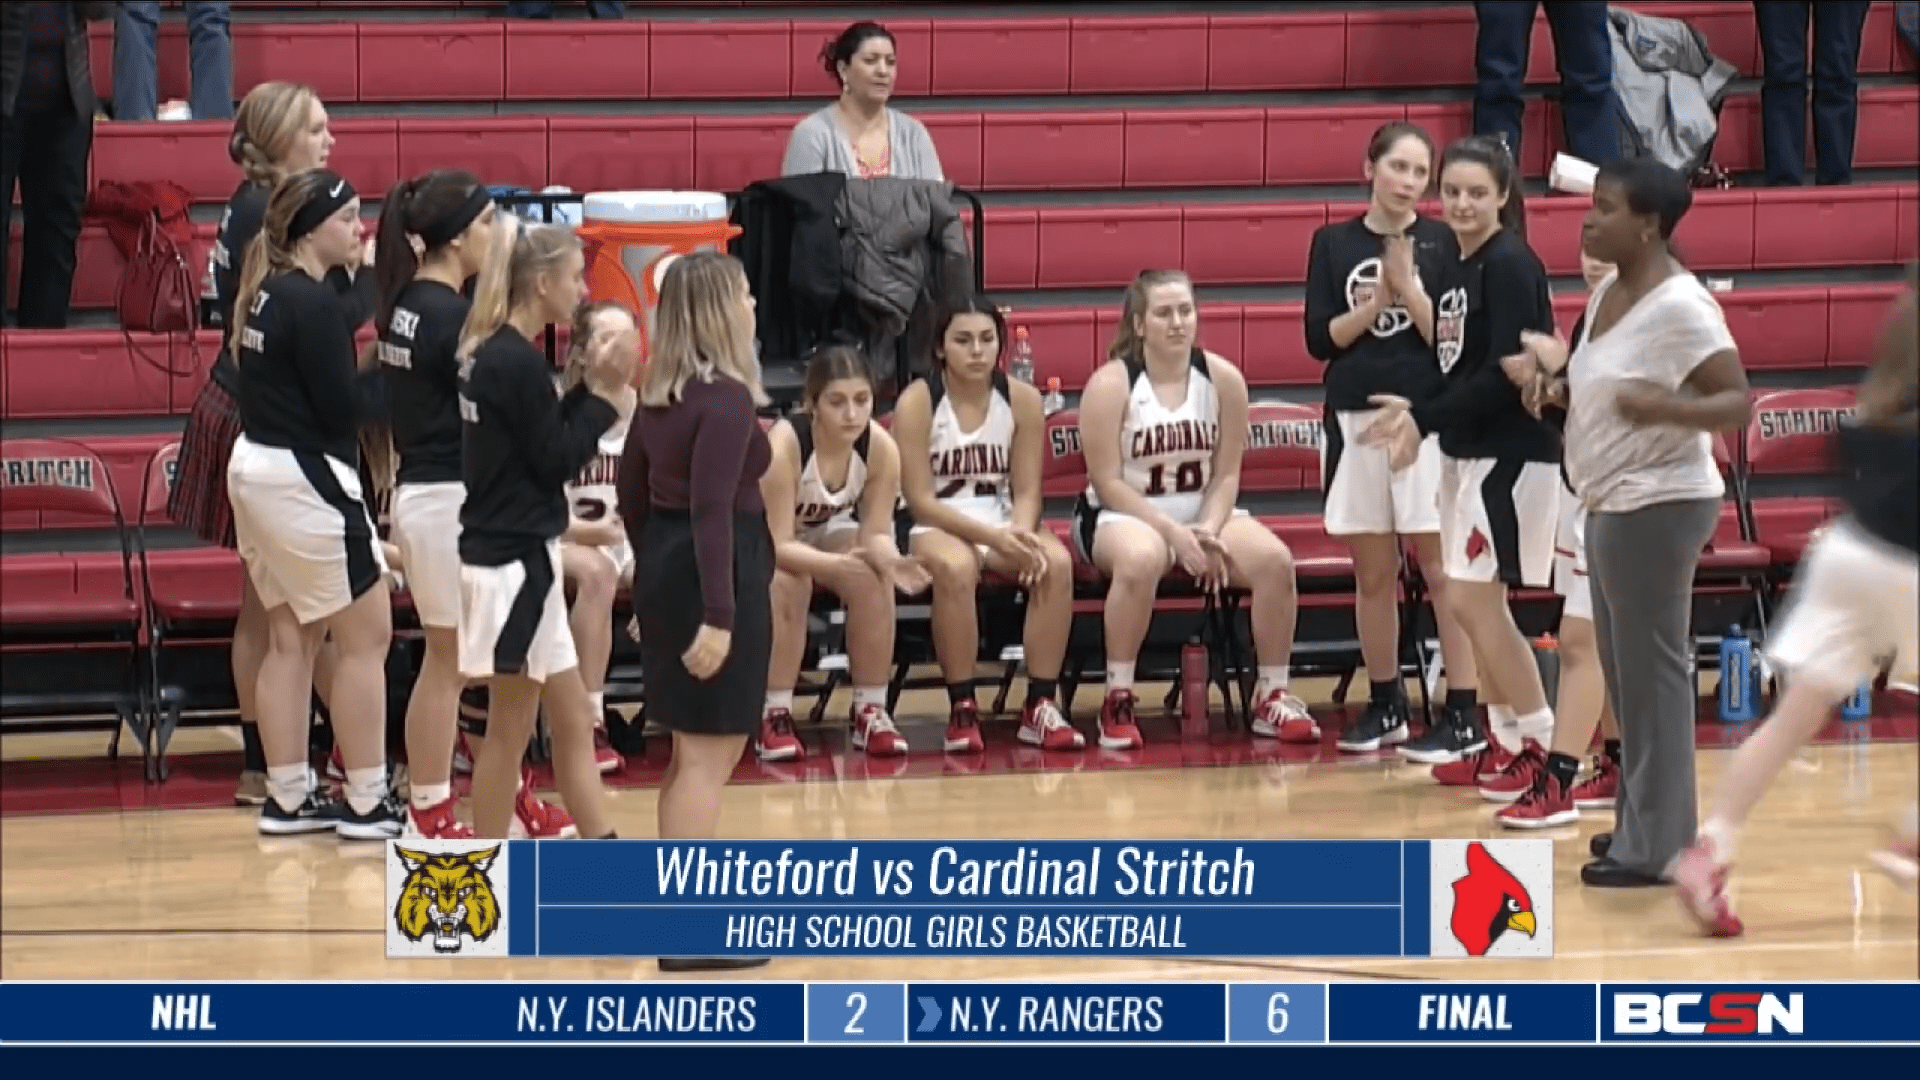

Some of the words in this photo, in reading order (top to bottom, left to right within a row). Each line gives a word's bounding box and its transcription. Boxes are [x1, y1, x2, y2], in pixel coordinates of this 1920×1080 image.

[0, 458, 93, 491] RITCH
[930, 443, 1011, 477] CARDINAL
[1145, 461, 1203, 495] 10
